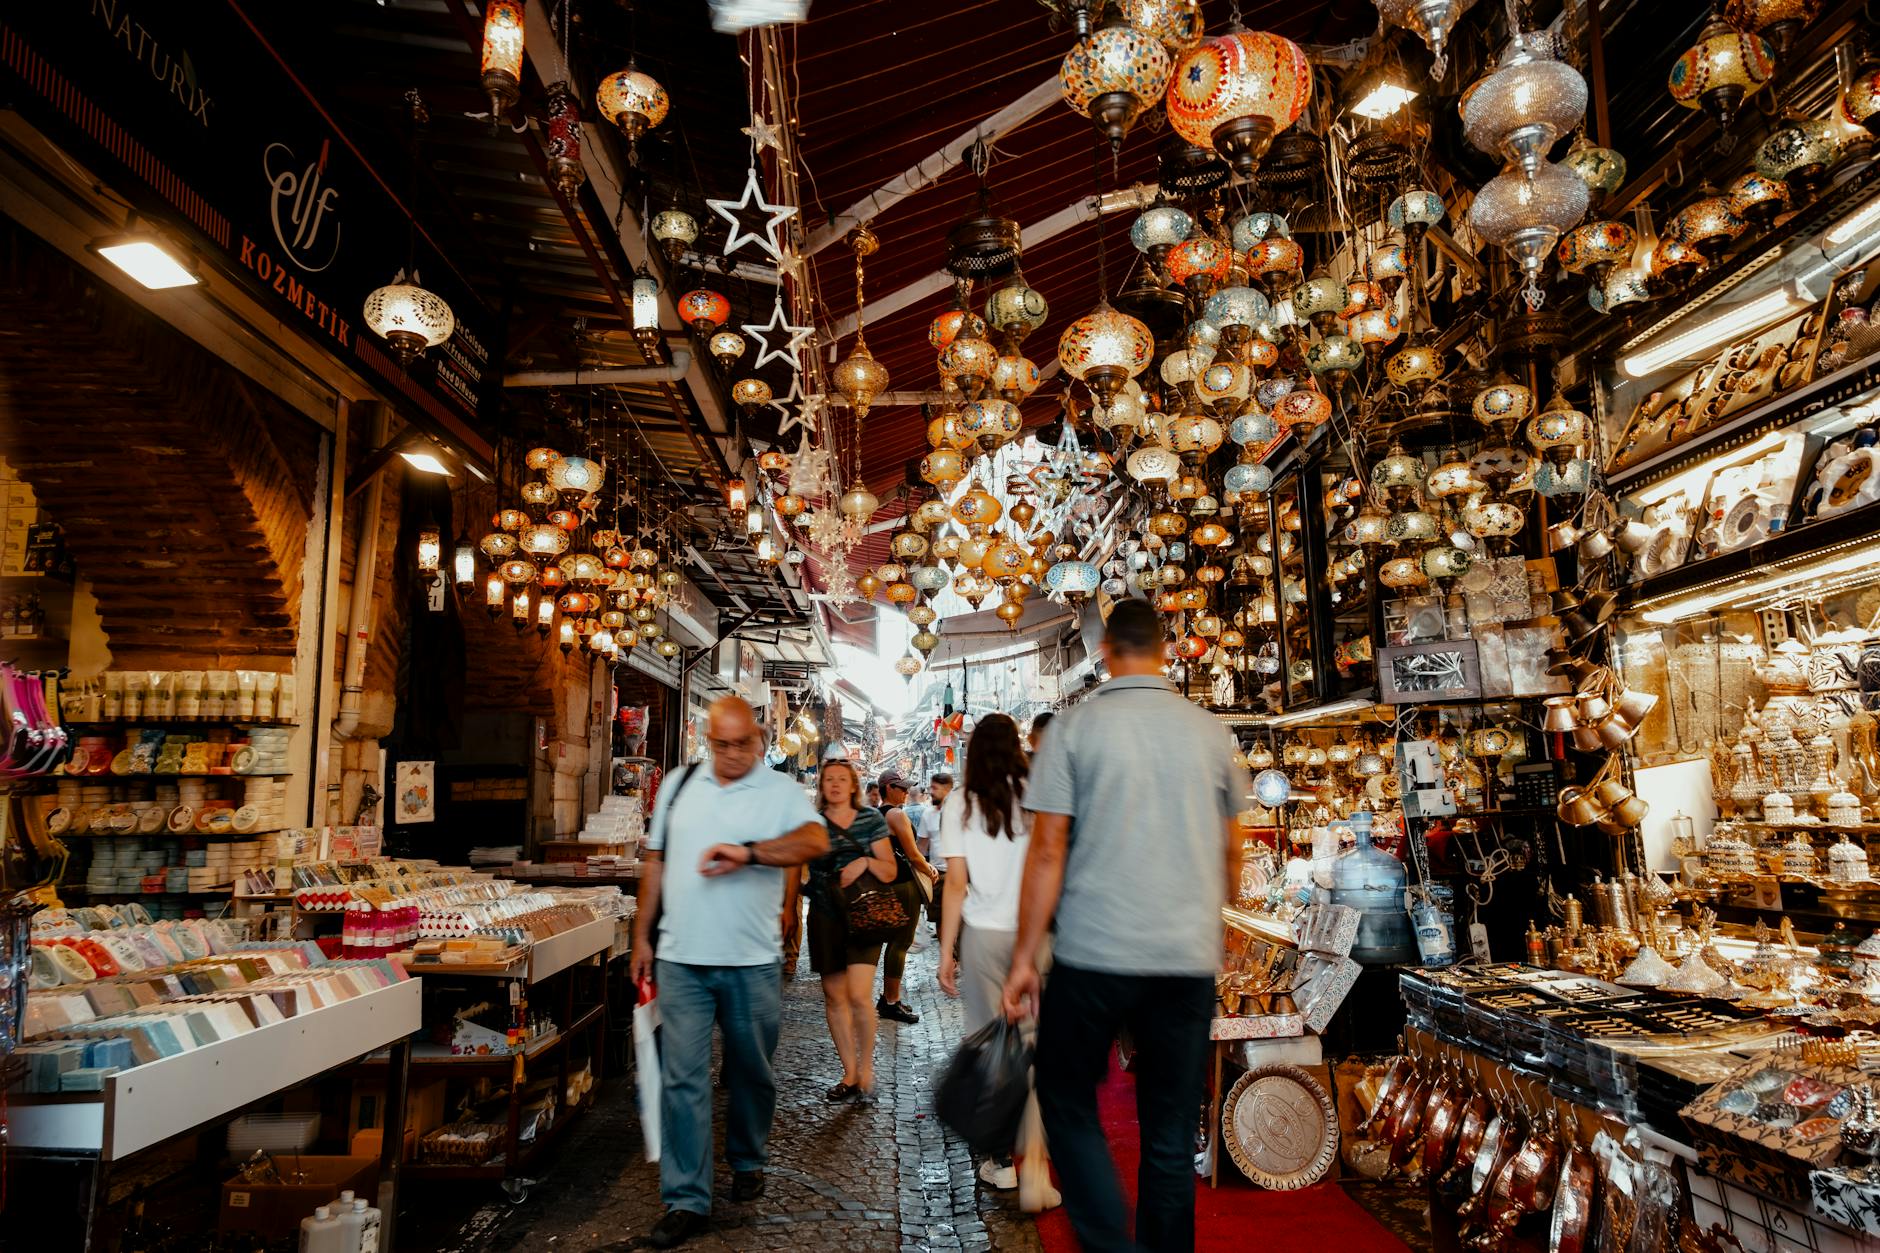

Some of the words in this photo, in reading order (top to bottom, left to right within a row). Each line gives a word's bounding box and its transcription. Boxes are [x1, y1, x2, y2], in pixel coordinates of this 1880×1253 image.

[239, 234, 351, 347] KOZMETİK
[450, 343, 482, 381] Freshener
[464, 327, 490, 361] Cologne
[437, 359, 455, 384] Reed
[453, 374, 479, 405] Diffuser
